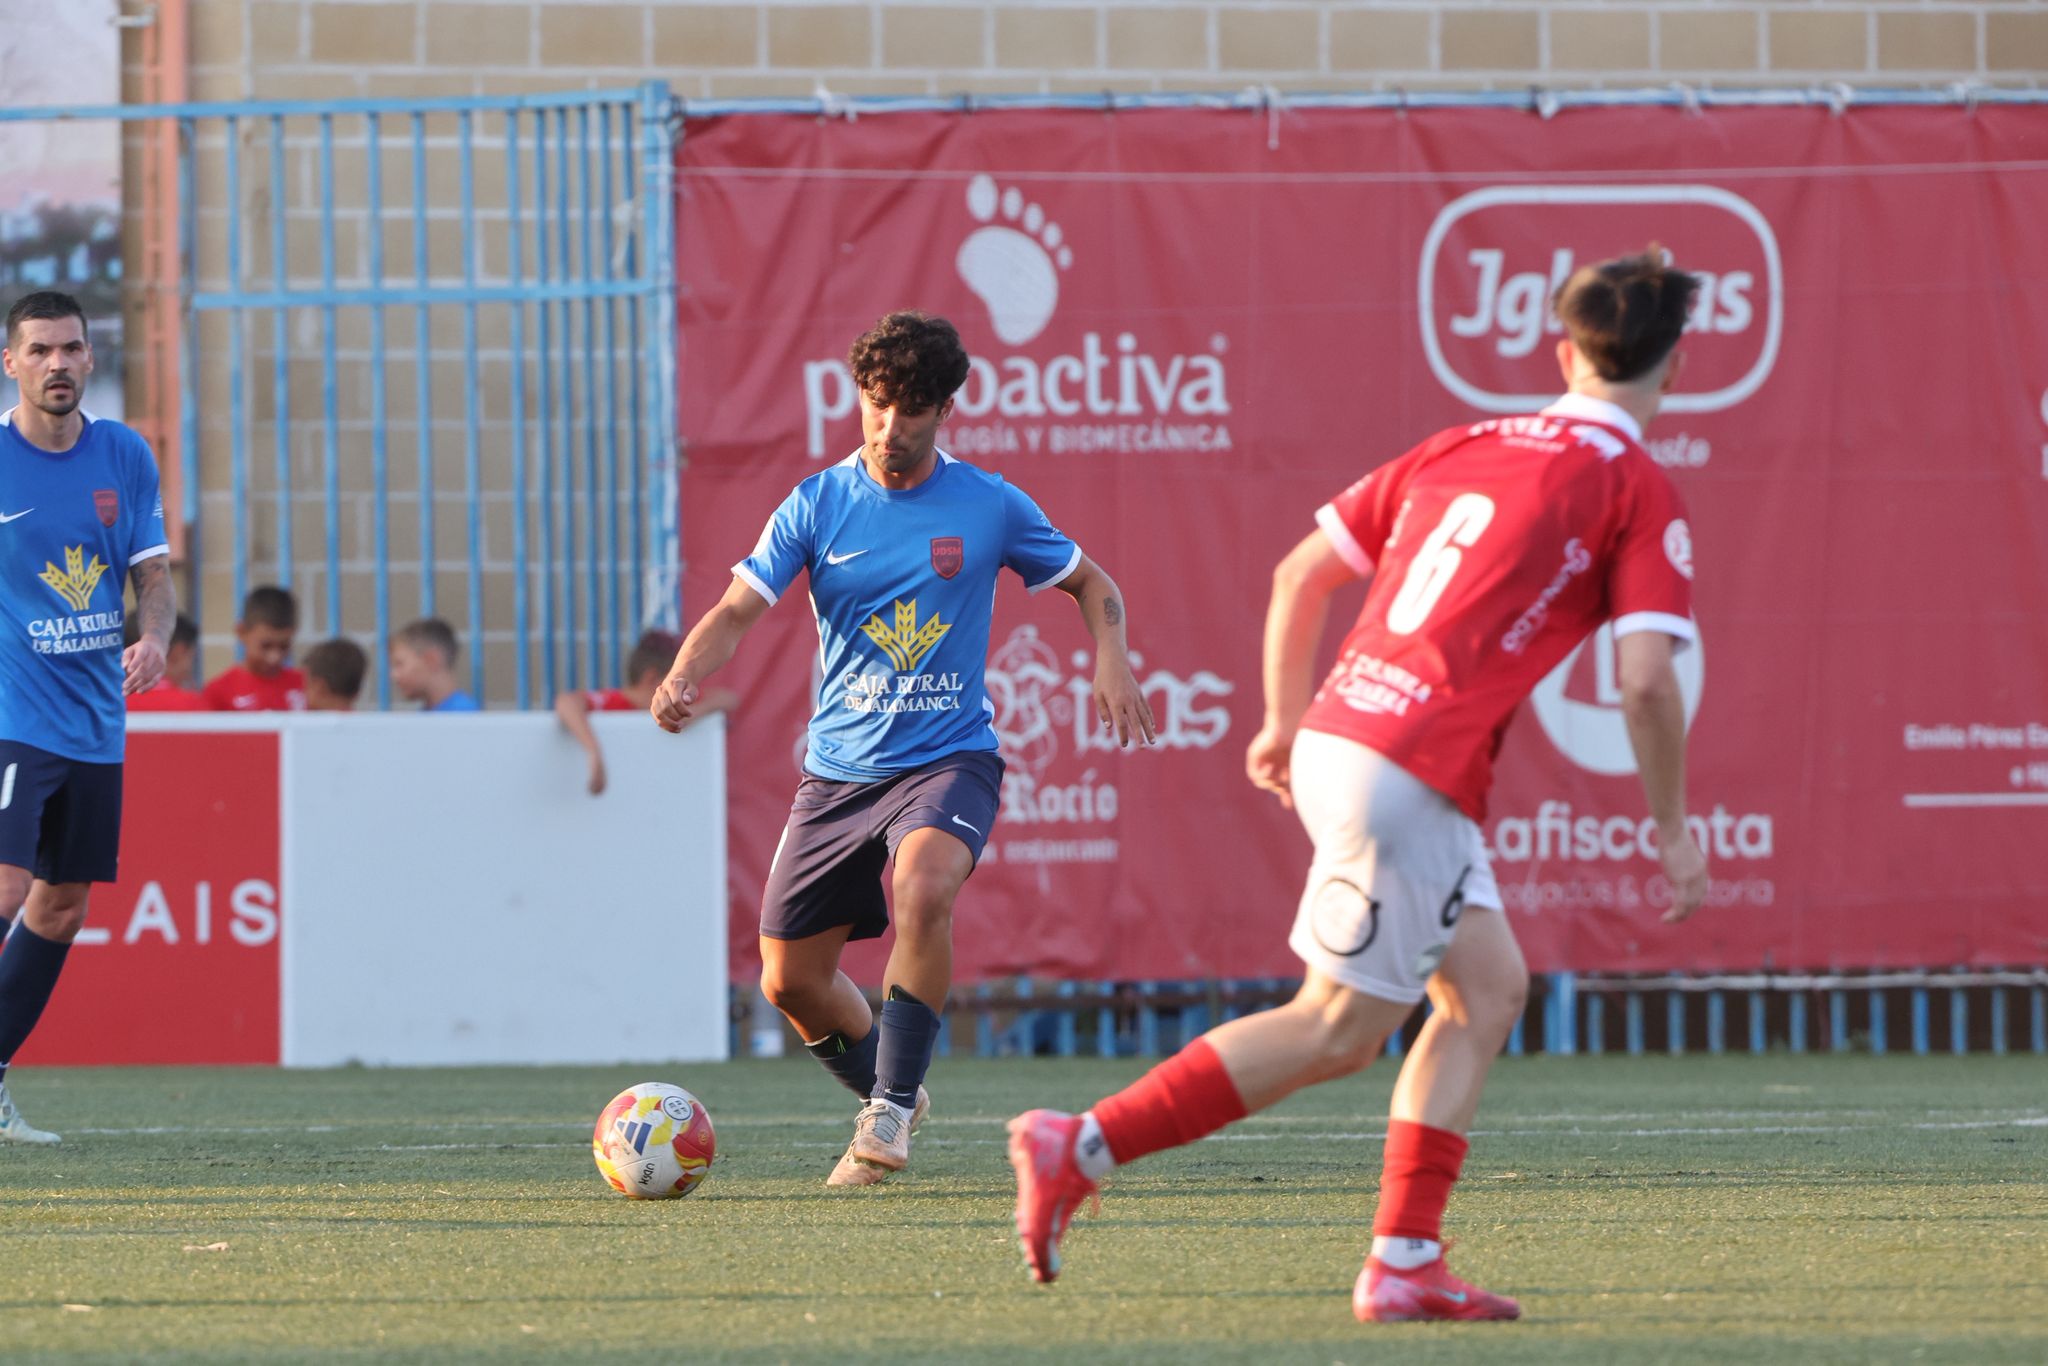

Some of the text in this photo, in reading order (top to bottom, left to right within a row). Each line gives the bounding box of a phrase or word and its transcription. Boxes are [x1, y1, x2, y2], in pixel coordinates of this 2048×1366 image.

[803, 332, 1231, 460] poactiva
[1025, 424, 1043, 452] Y
[1050, 416, 1232, 453] BIOMECÁNICA
[1387, 492, 1495, 636] 6
[28, 610, 123, 640] CAJA RURAL
[32, 631, 122, 655] DE SALAMANCA
[843, 672, 963, 697] CAJA RURAL
[842, 694, 960, 713] DE SALAMANCA
[1440, 863, 1472, 928] 6
